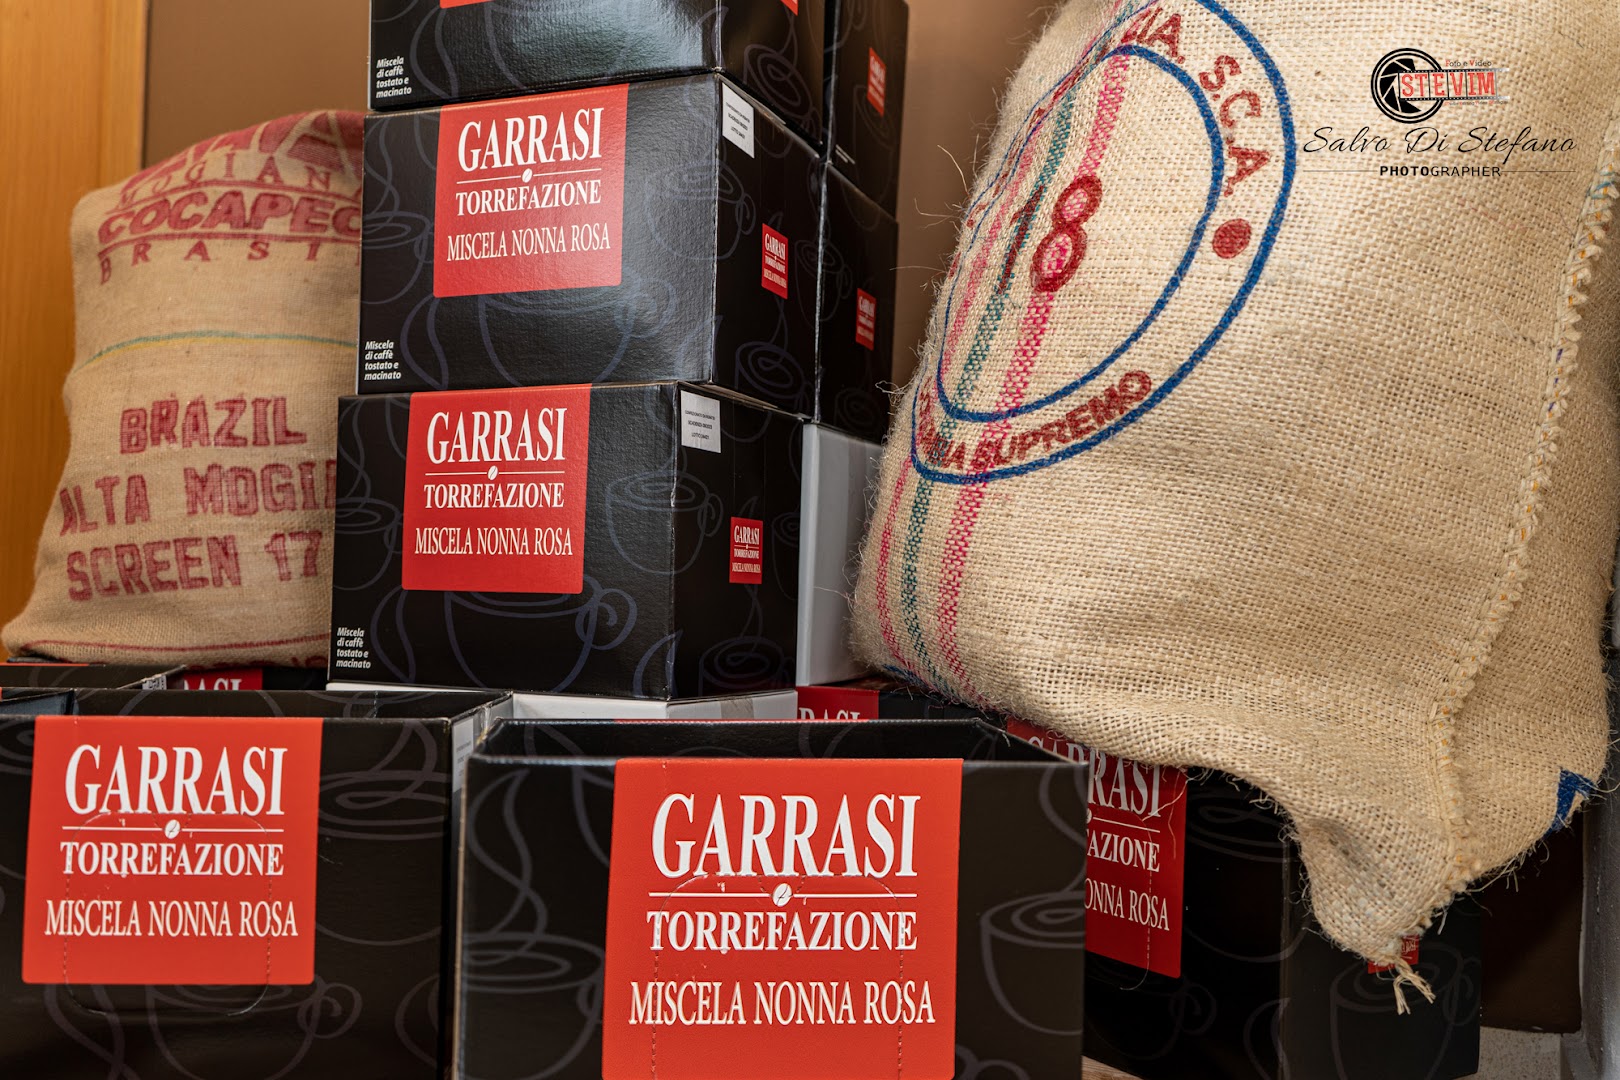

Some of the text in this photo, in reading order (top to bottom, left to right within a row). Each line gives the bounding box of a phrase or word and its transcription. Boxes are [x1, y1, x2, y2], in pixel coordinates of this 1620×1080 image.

[376, 55, 404, 68] Miscela
[376, 66, 404, 78] di caffè
[376, 78, 403, 89] tostato
[376, 86, 412, 98] macinato
[458, 107, 604, 172] GARRASI
[456, 180, 601, 216] TORREFAZIONE
[447, 222, 611, 262] MISCELA NONNA ROSA
[99, 238, 361, 285] BRASI
[365, 340, 394, 351] Miscela
[365, 350, 393, 361] di caffè
[364, 361, 392, 371] tostato
[364, 371, 401, 381] macinato
[120, 397, 307, 455] BRAZIL
[427, 407, 567, 464] GARRASI
[60, 474, 150, 537] ALTA
[424, 482, 564, 508] TORREFAZIONE
[415, 527, 573, 556] MISCELA NONNA ROSA
[734, 525, 760, 545] GARRASI
[67, 530, 322, 602] SCREEN 17
[337, 627, 364, 637] Miscela
[337, 638, 363, 648] di caffè
[336, 659, 371, 669] macinato
[337, 649, 363, 659] tostato
[65, 744, 288, 817] GARRASI
[652, 793, 921, 878] GARRASI
[1087, 829, 1160, 873] AZIONE
[60, 841, 284, 876] TORREFAZIONE
[44, 899, 299, 937] MISCELA NONNA ROSA
[1128, 889, 1170, 931] ROSA
[646, 911, 918, 950] TORREFAZIONE
[628, 980, 936, 1025] MISCELA NONNA ROSA
